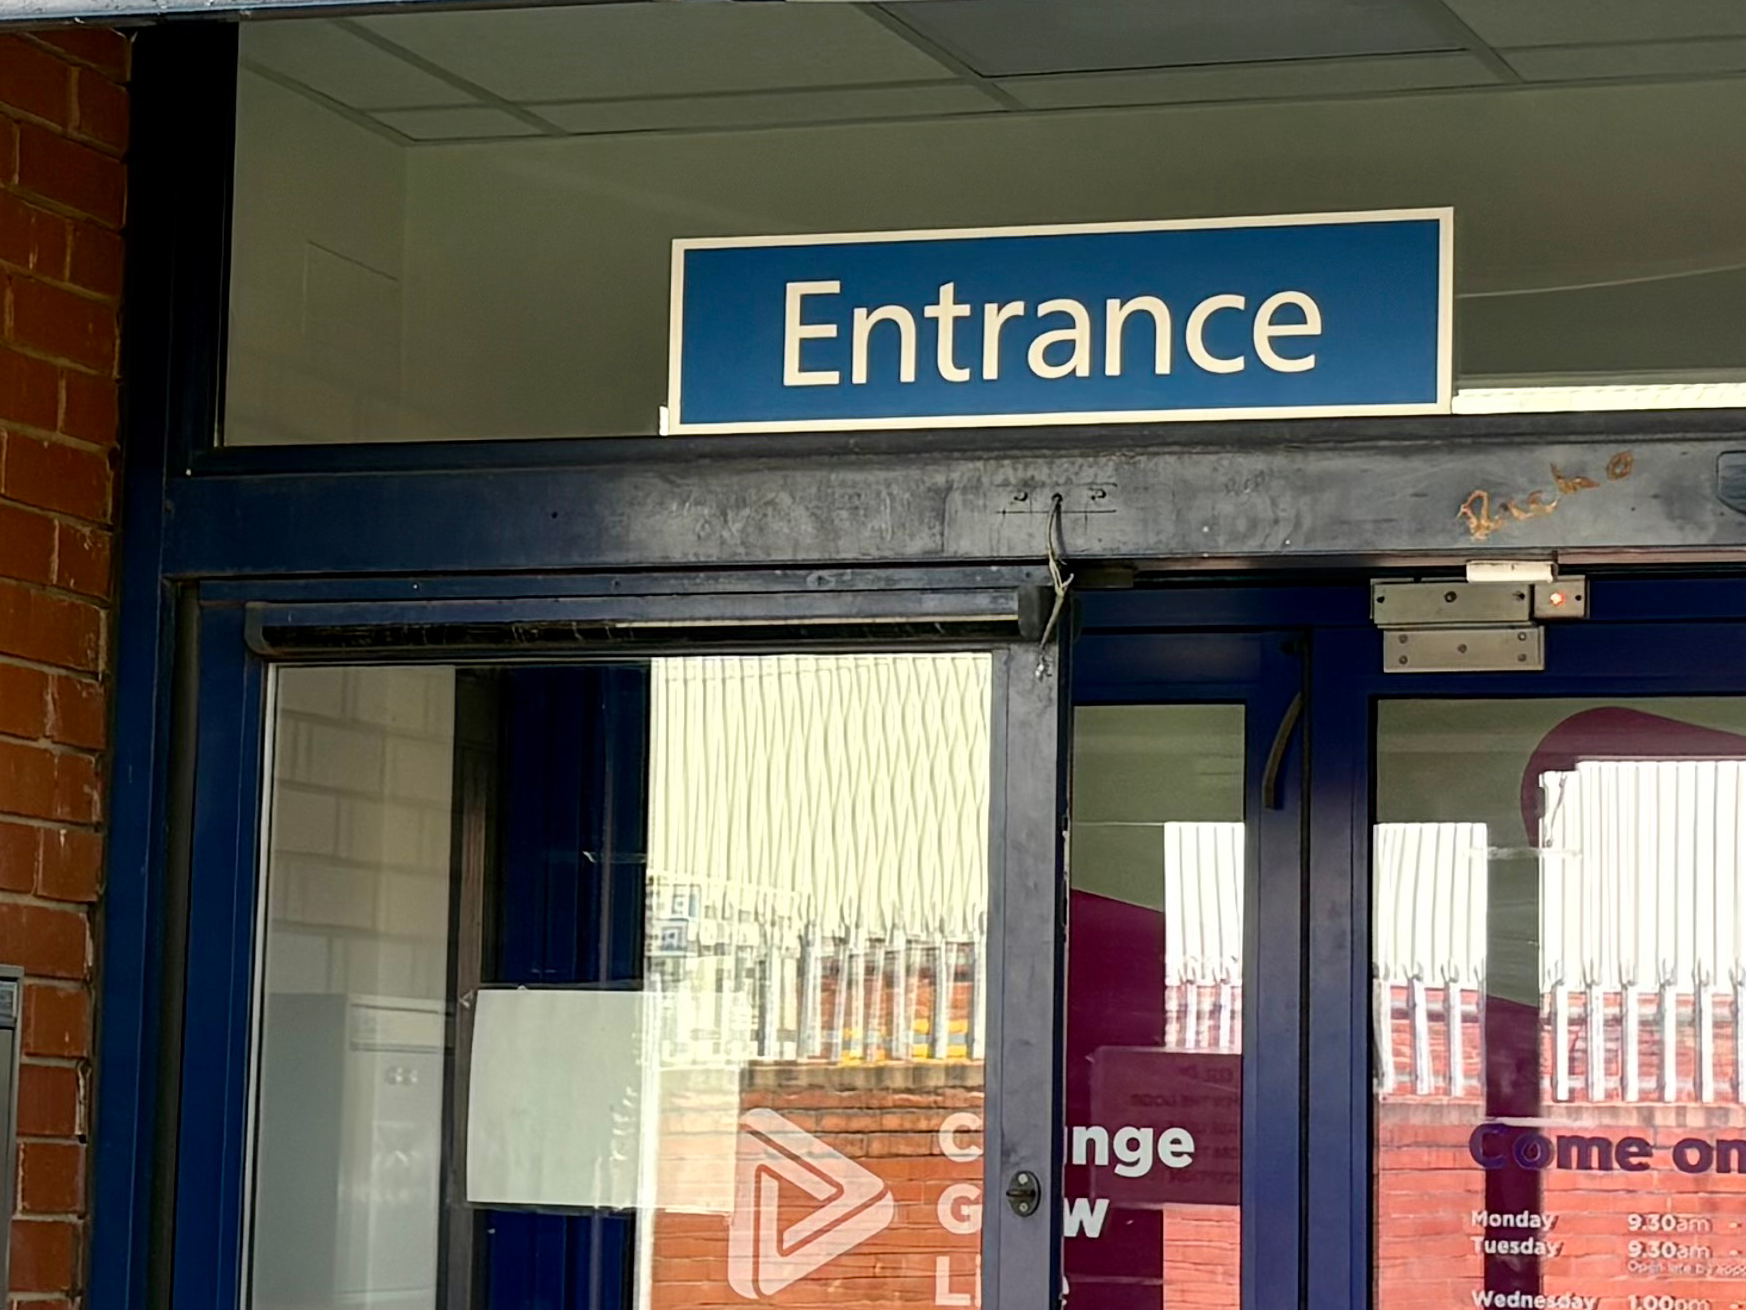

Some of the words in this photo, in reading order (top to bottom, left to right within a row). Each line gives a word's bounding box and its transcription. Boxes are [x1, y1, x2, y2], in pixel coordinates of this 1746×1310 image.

[782, 279, 1324, 388] Entrance
[937, 1111, 1196, 1179] Cnge
[1468, 1122, 1654, 1173] Come
[1471, 1209, 1556, 1231] Monday
[1627, 1213, 1711, 1233] 9.30am
[1470, 1236, 1561, 1258] Tuesday
[1627, 1240, 1712, 1259] 9.30am
